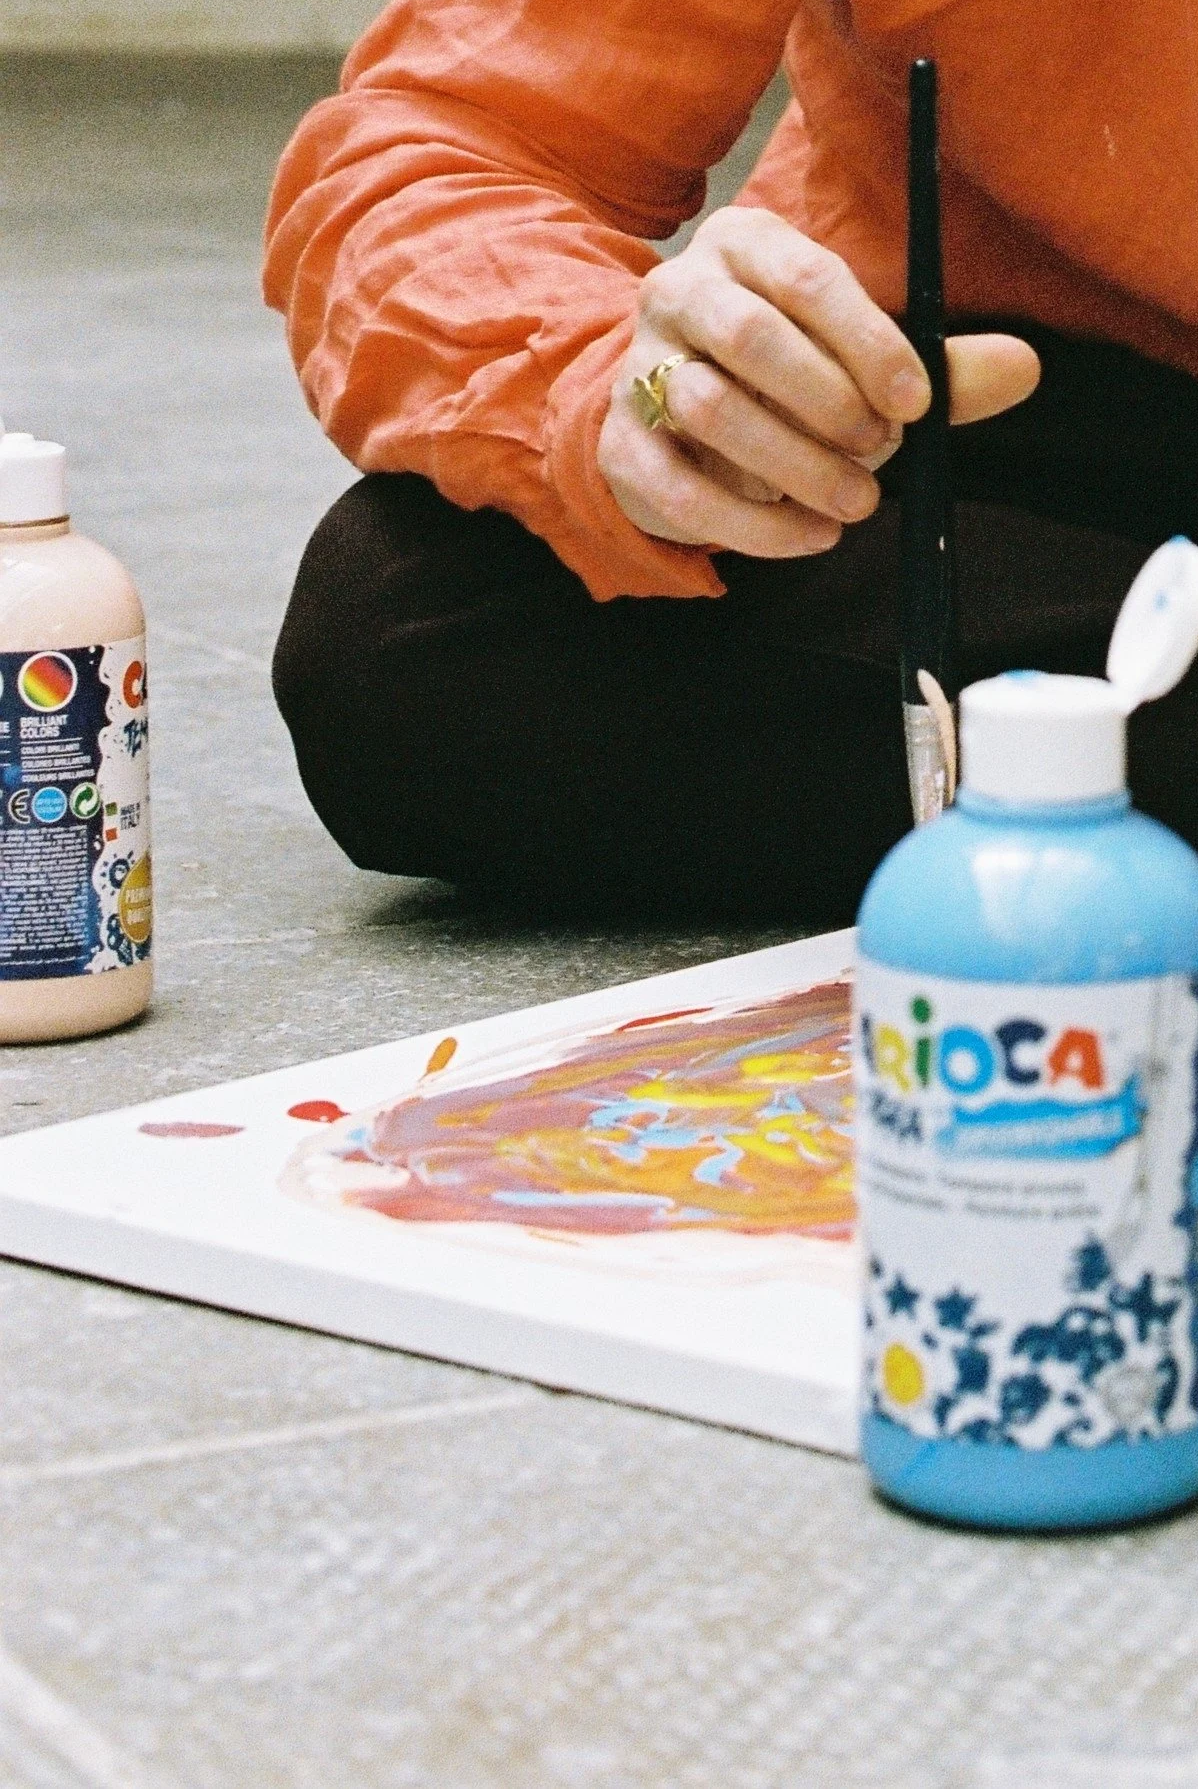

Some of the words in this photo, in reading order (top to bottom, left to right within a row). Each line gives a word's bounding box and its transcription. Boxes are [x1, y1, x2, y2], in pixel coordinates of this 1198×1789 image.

[20, 715, 68, 727] BRILLIANT
[20, 727, 60, 738] COLORS
[120, 812, 141, 830] ITALY
